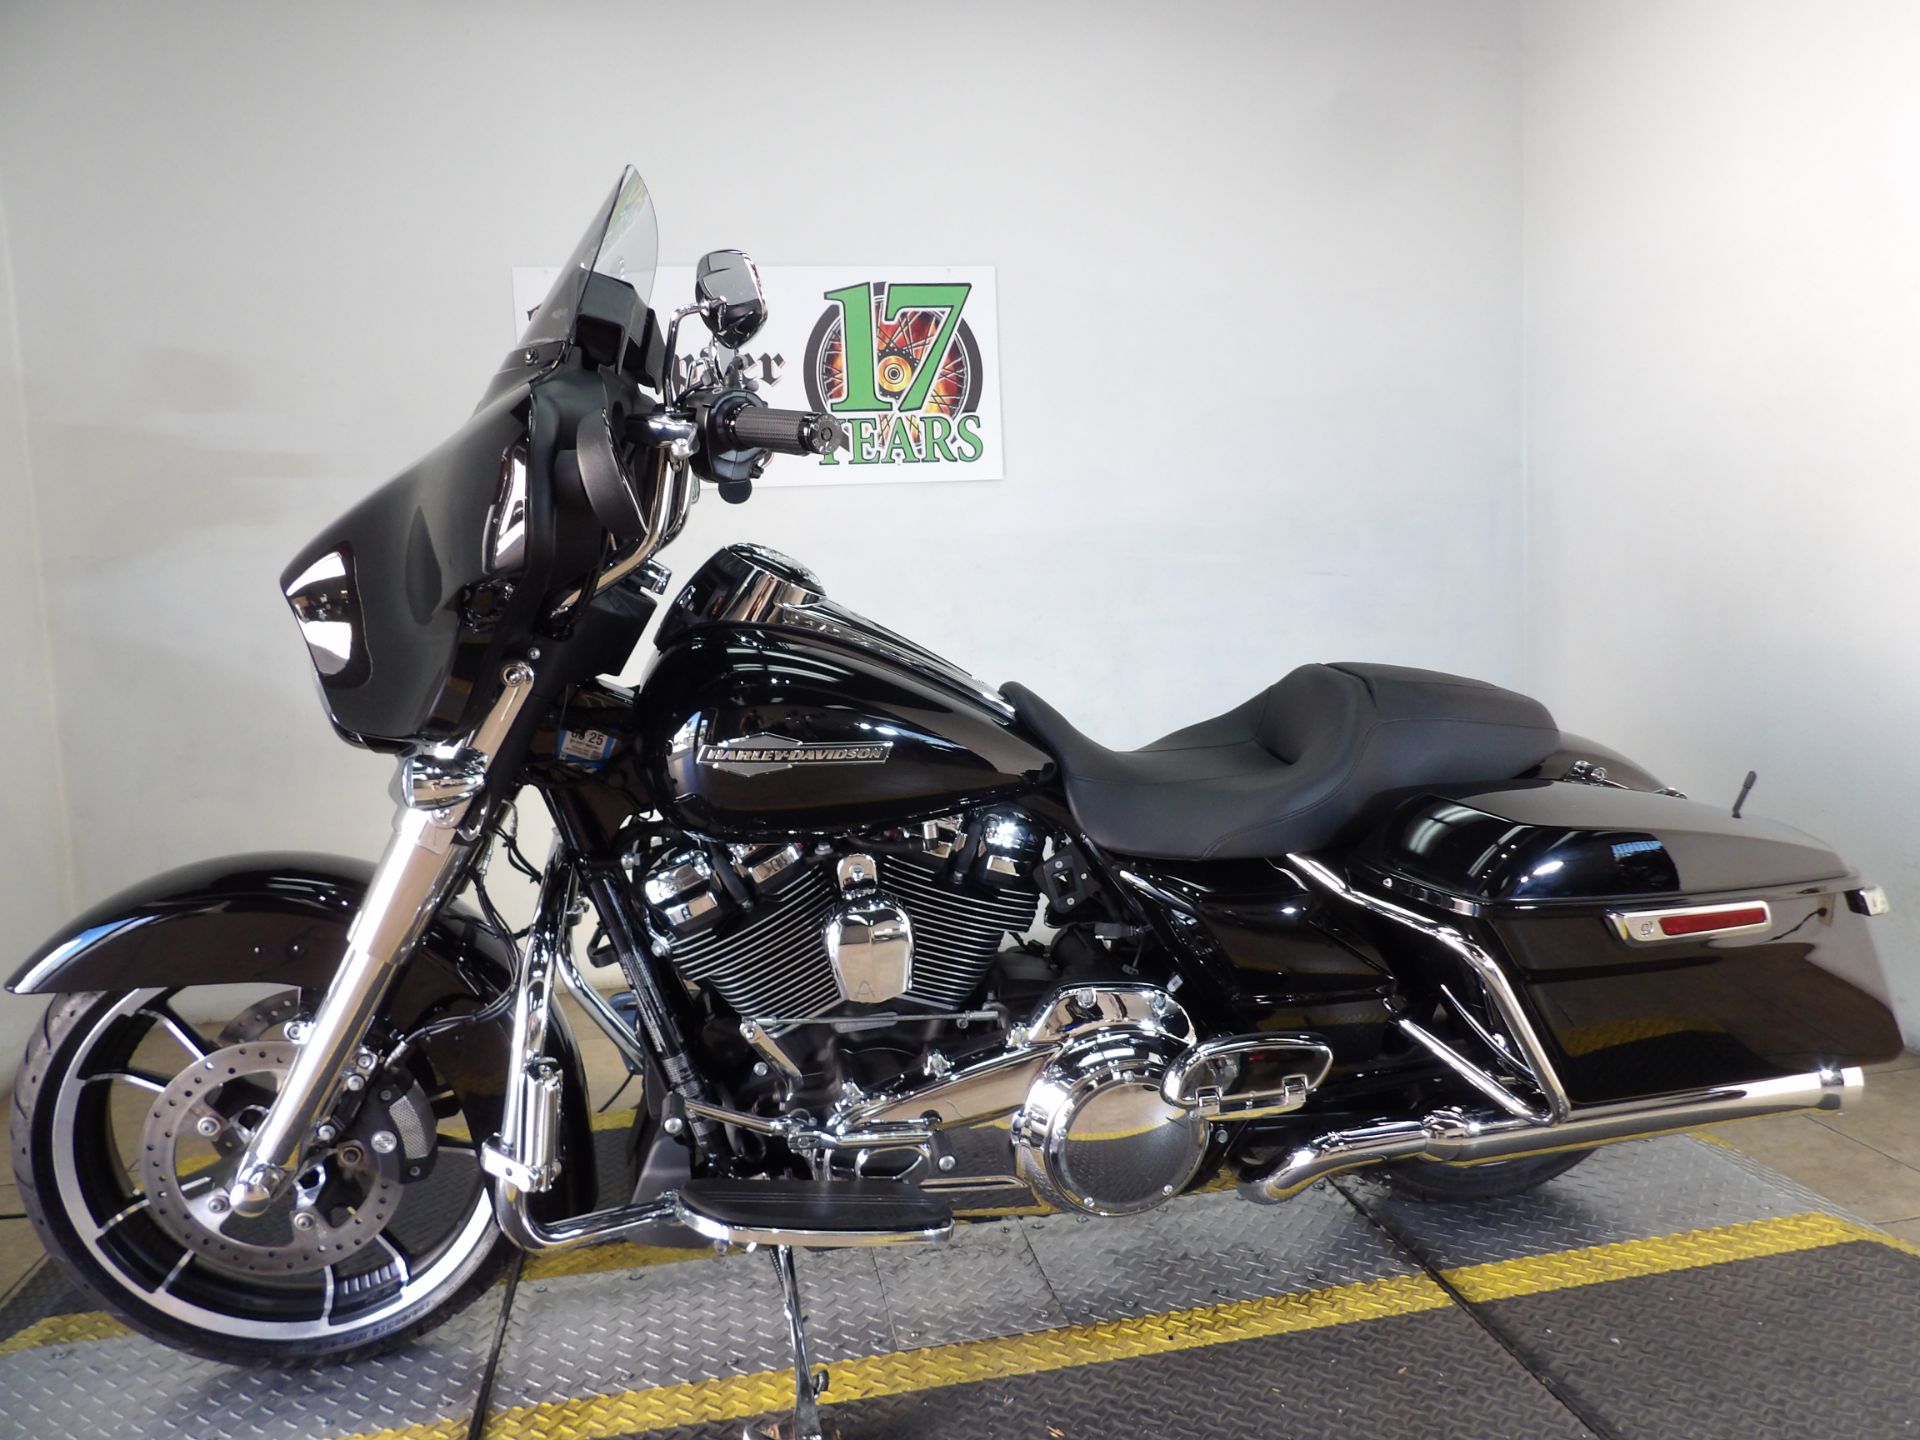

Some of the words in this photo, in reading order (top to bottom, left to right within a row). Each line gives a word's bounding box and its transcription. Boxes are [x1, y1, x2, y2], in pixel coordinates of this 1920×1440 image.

[824, 281, 972, 412] 17
[588, 732, 604, 746] 25
[706, 746, 884, 761] HARLEY-DAVIDSON
